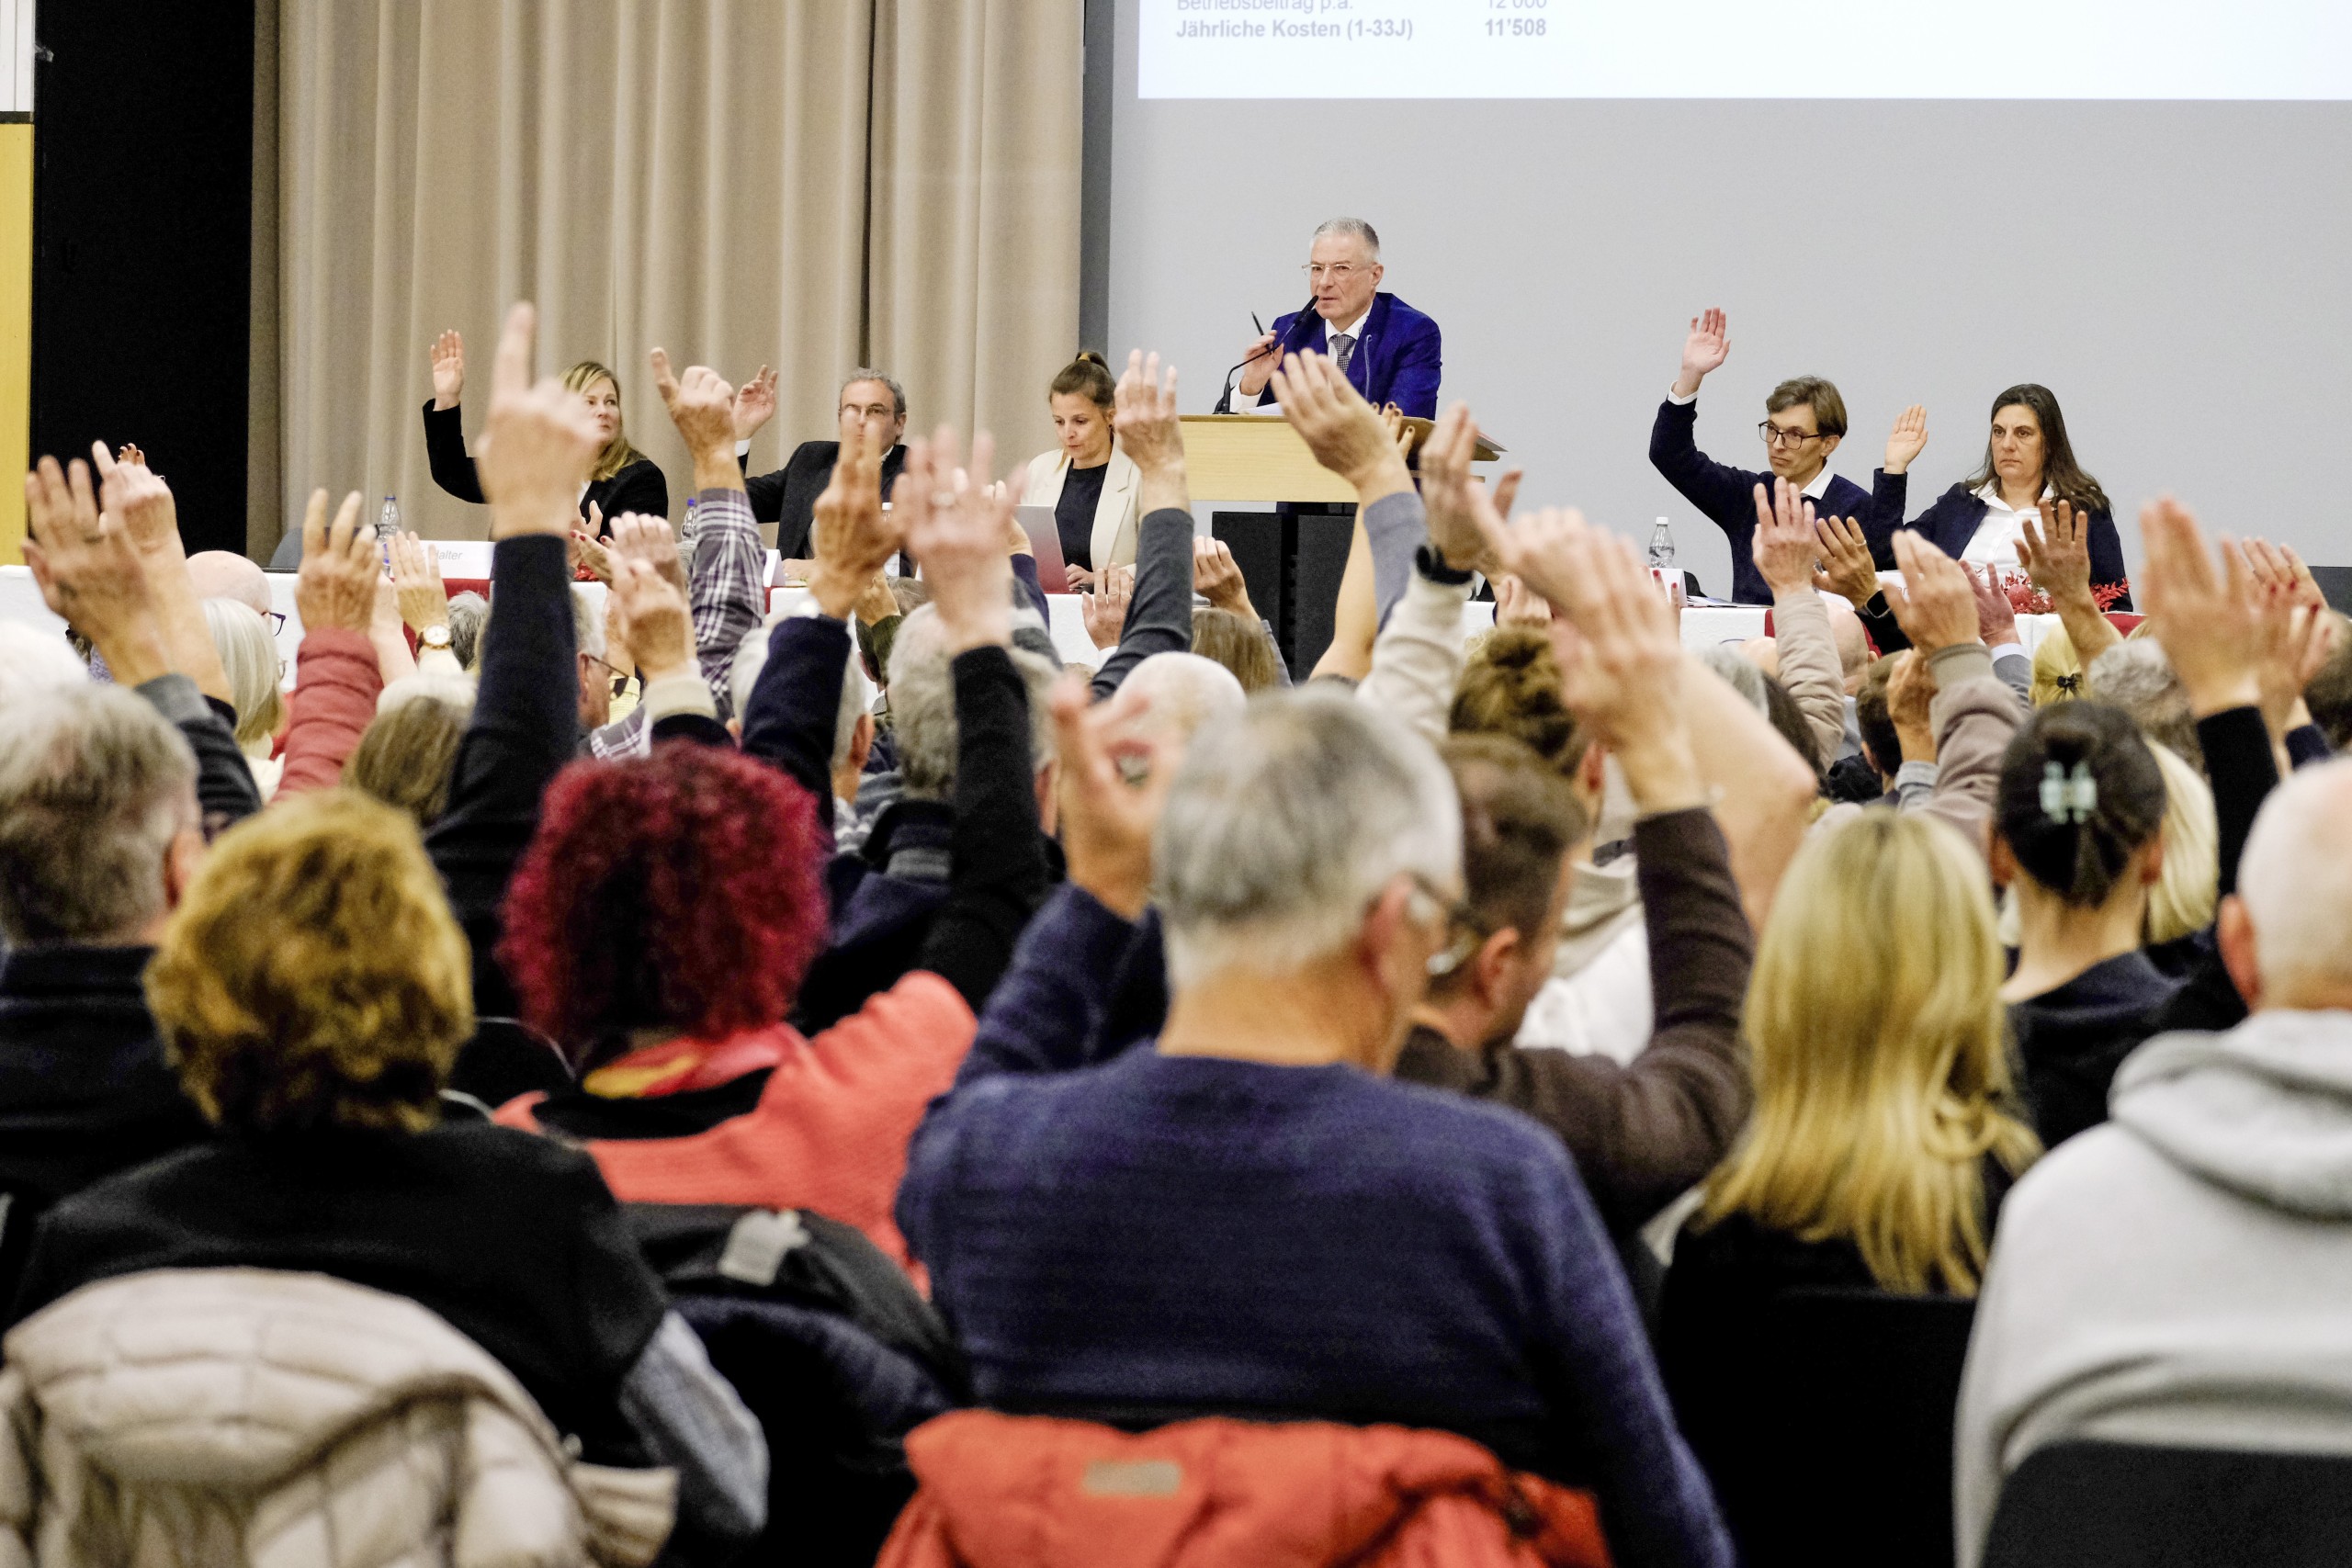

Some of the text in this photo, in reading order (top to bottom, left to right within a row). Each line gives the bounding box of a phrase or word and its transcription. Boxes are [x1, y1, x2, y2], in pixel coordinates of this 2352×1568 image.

[1176, 18, 1413, 40] Jährliche Kosten (1-33J)
